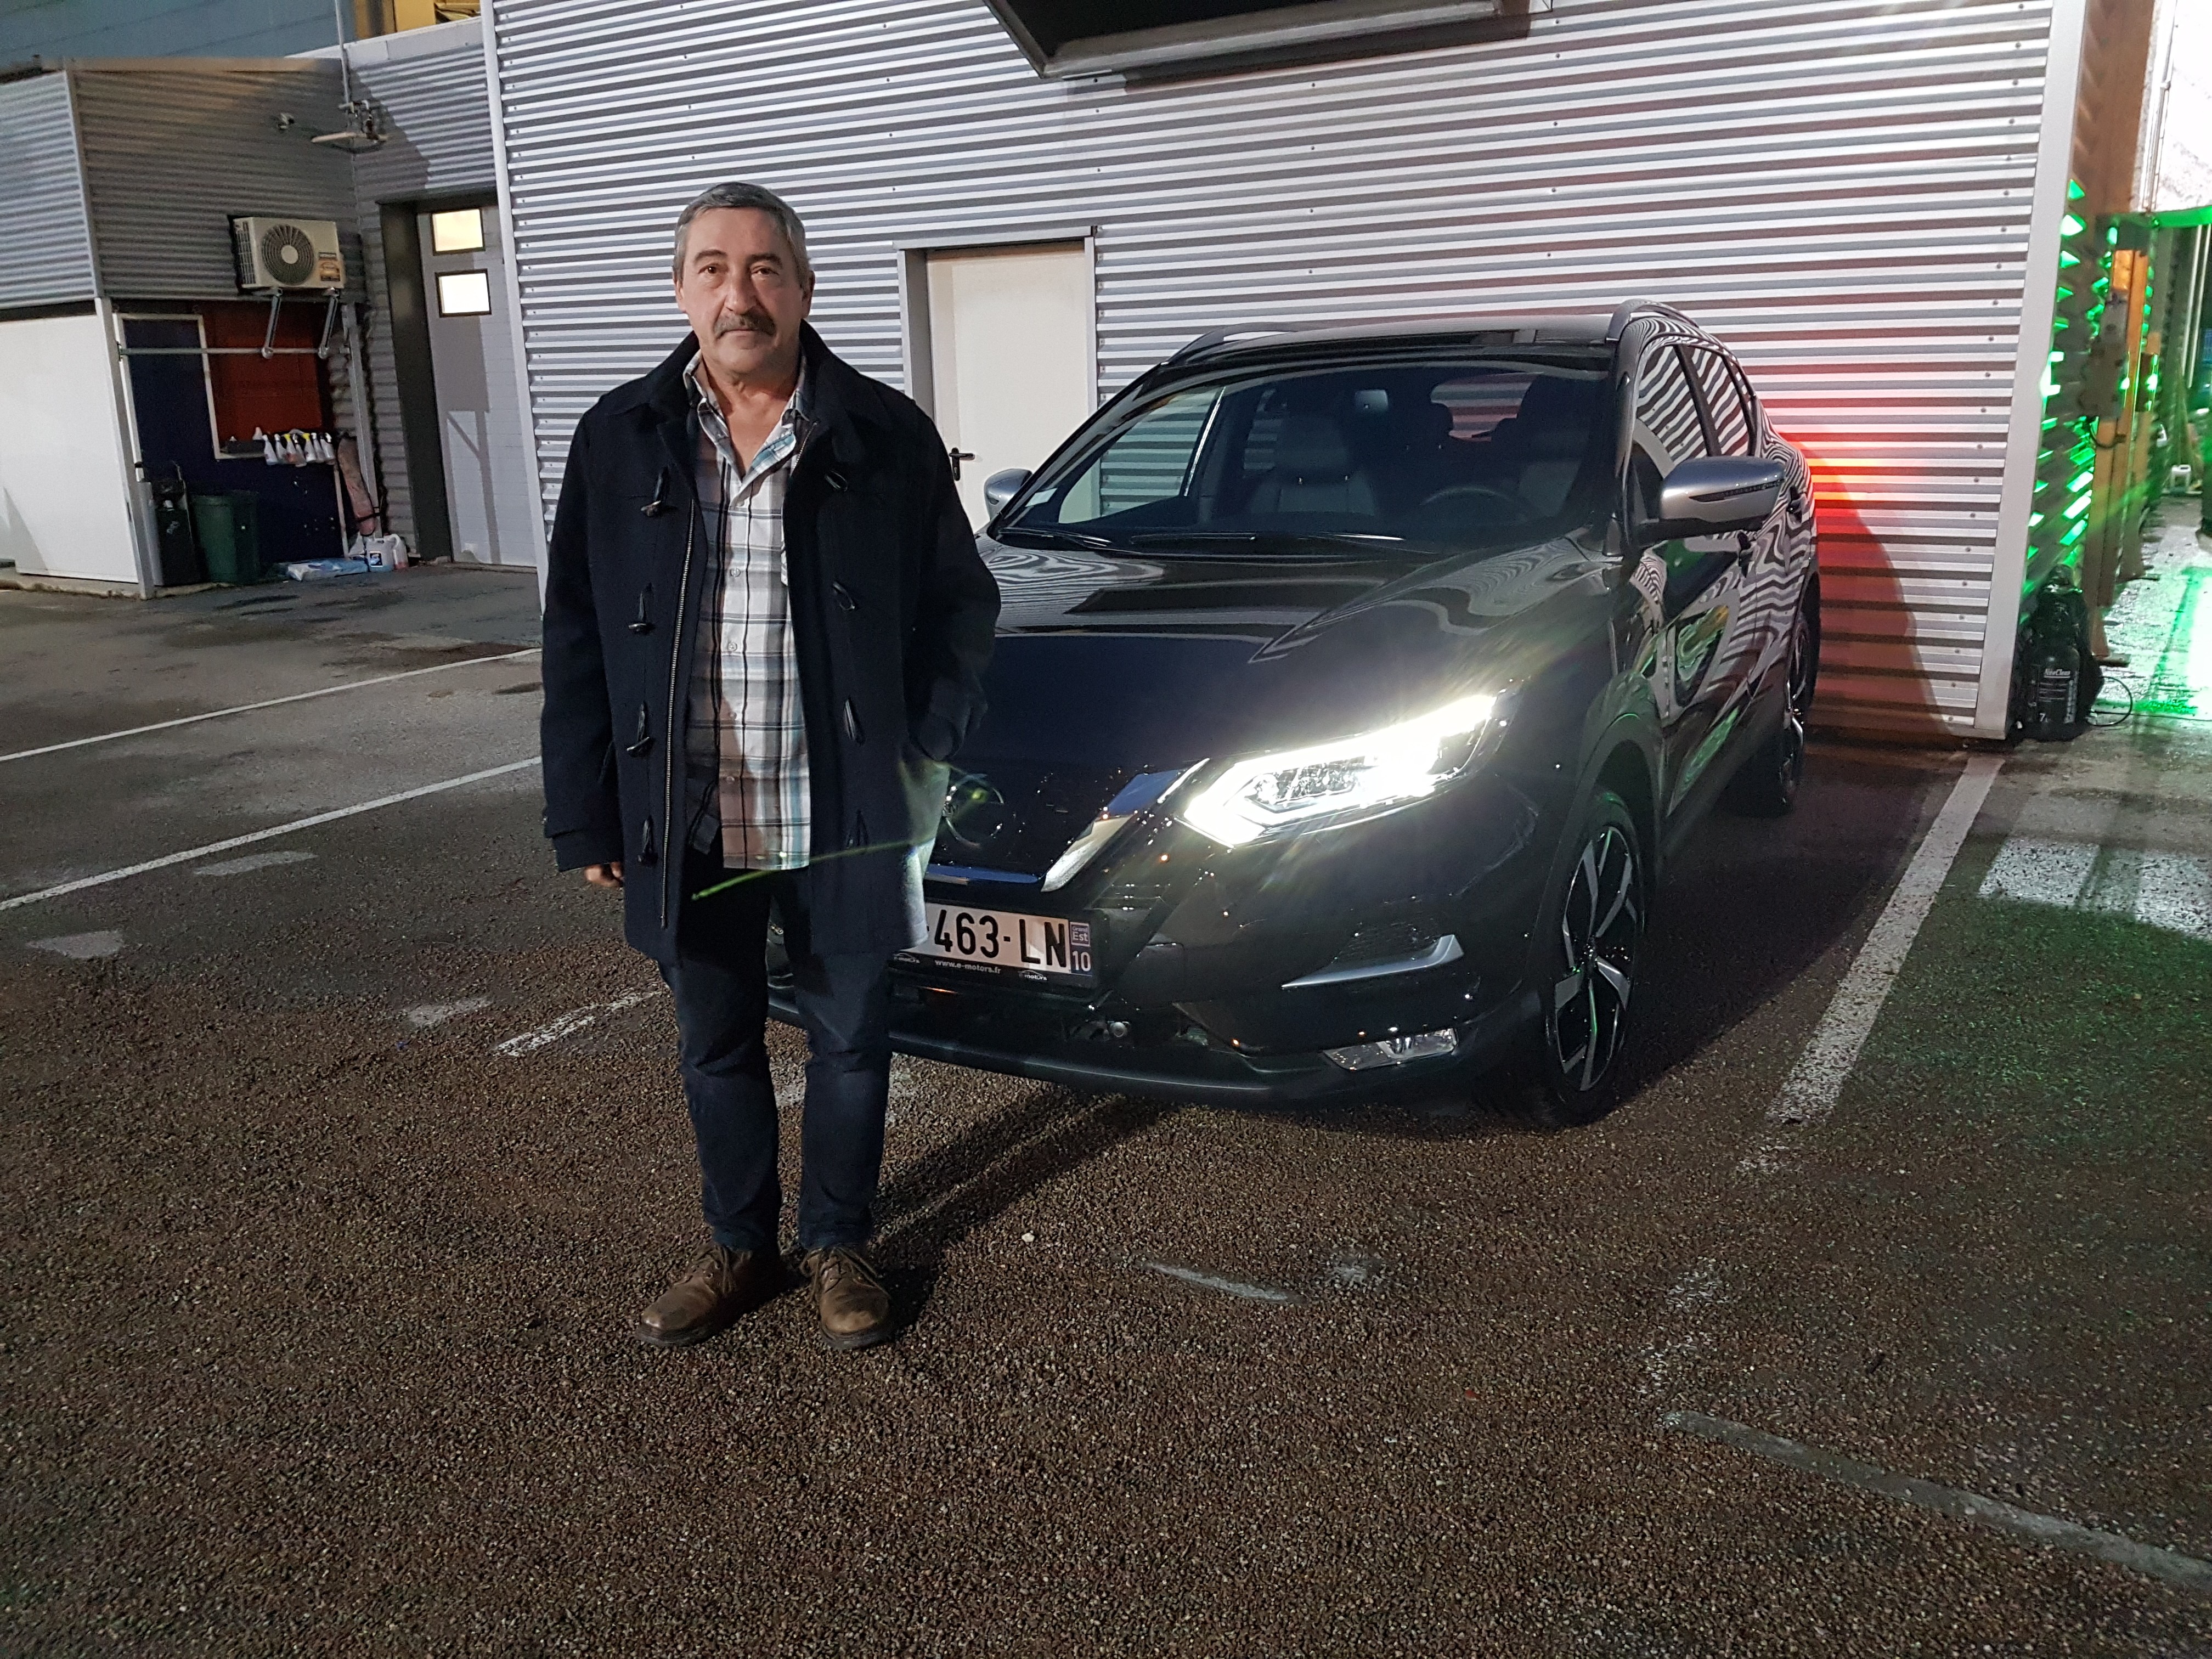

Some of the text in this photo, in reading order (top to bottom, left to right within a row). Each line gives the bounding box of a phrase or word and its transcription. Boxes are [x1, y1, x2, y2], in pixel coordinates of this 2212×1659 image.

[1073, 931, 1088, 942] Est
[934, 960, 1001, 974] www.e-motors.fr
[1073, 951, 1091, 972] 10
